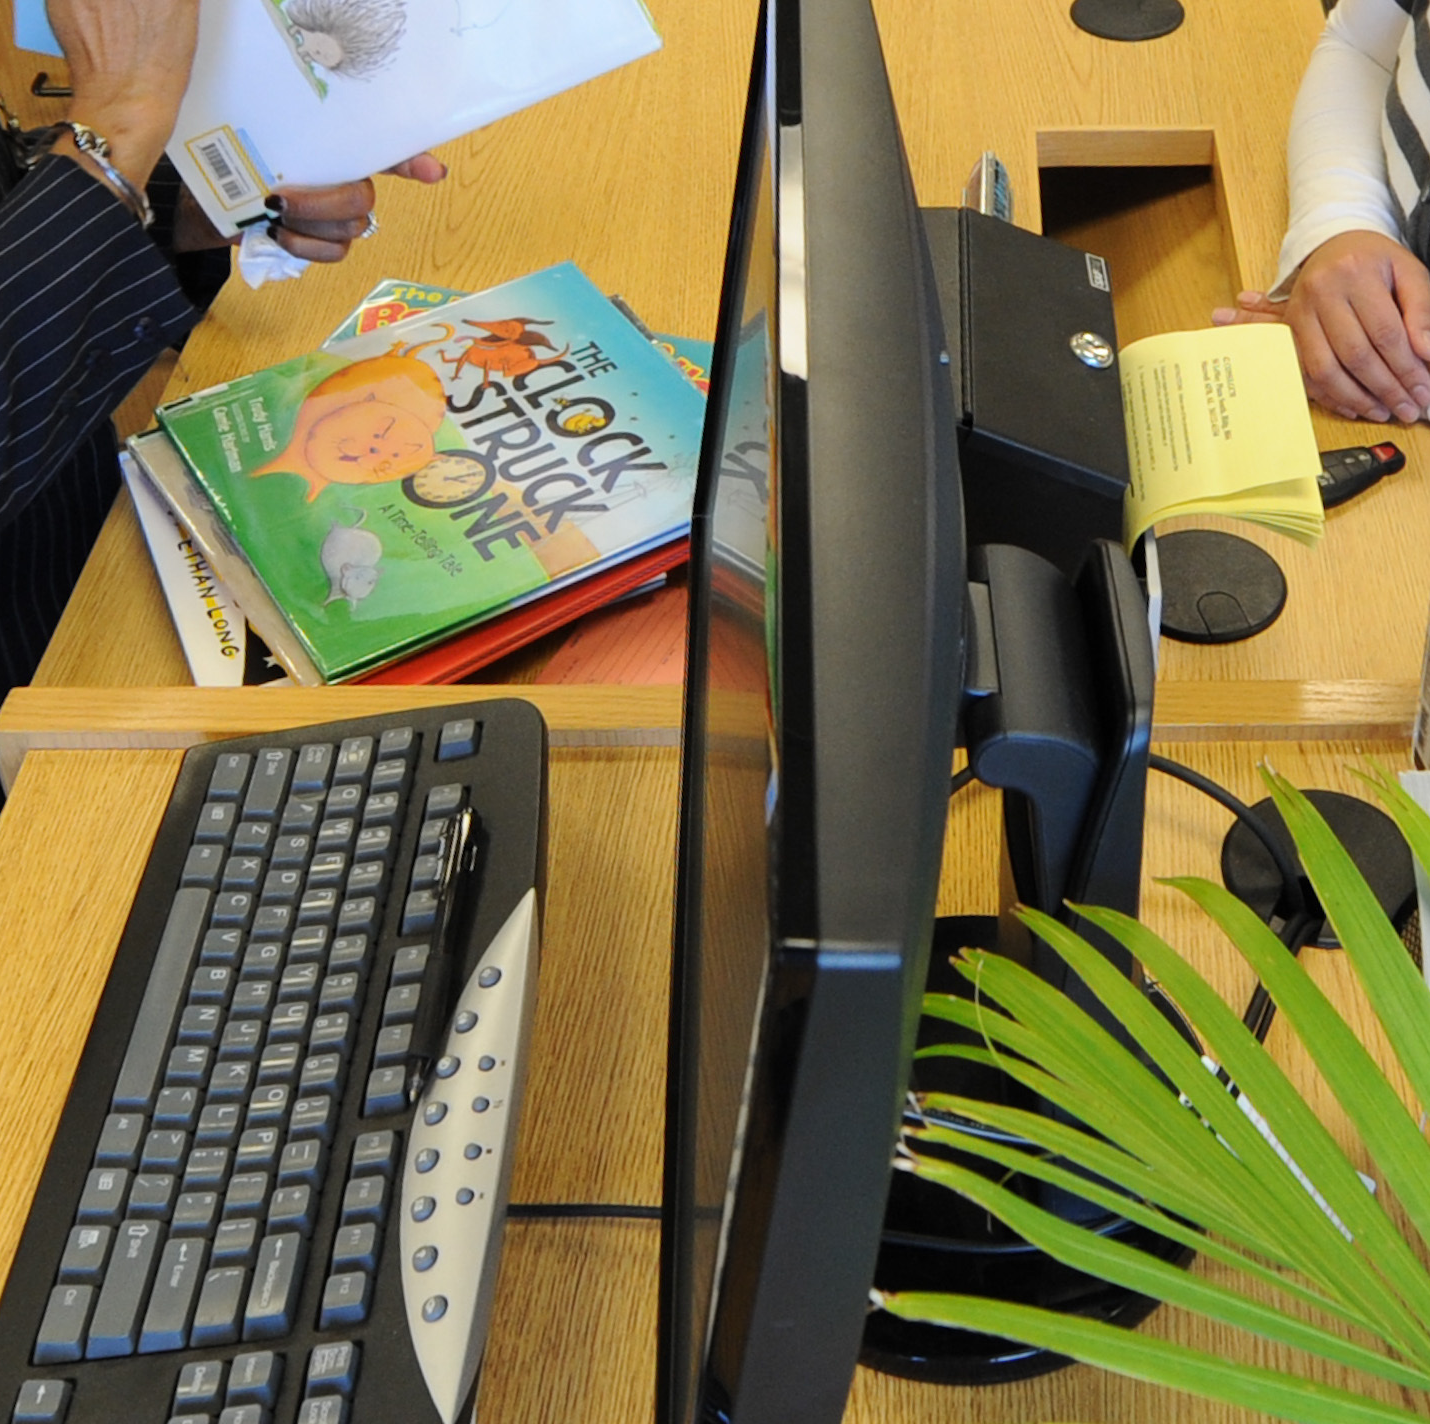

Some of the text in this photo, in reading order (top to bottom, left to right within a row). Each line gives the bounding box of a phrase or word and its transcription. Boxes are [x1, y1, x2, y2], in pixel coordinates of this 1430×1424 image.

[392, 286, 443, 304] The
[571, 340, 619, 379] THE
[445, 380, 611, 535] STRUCK
[511, 359, 669, 494] CLOCK
[401, 448, 542, 563] ONE
[177, 538, 240, 658] ETHAN LONG
